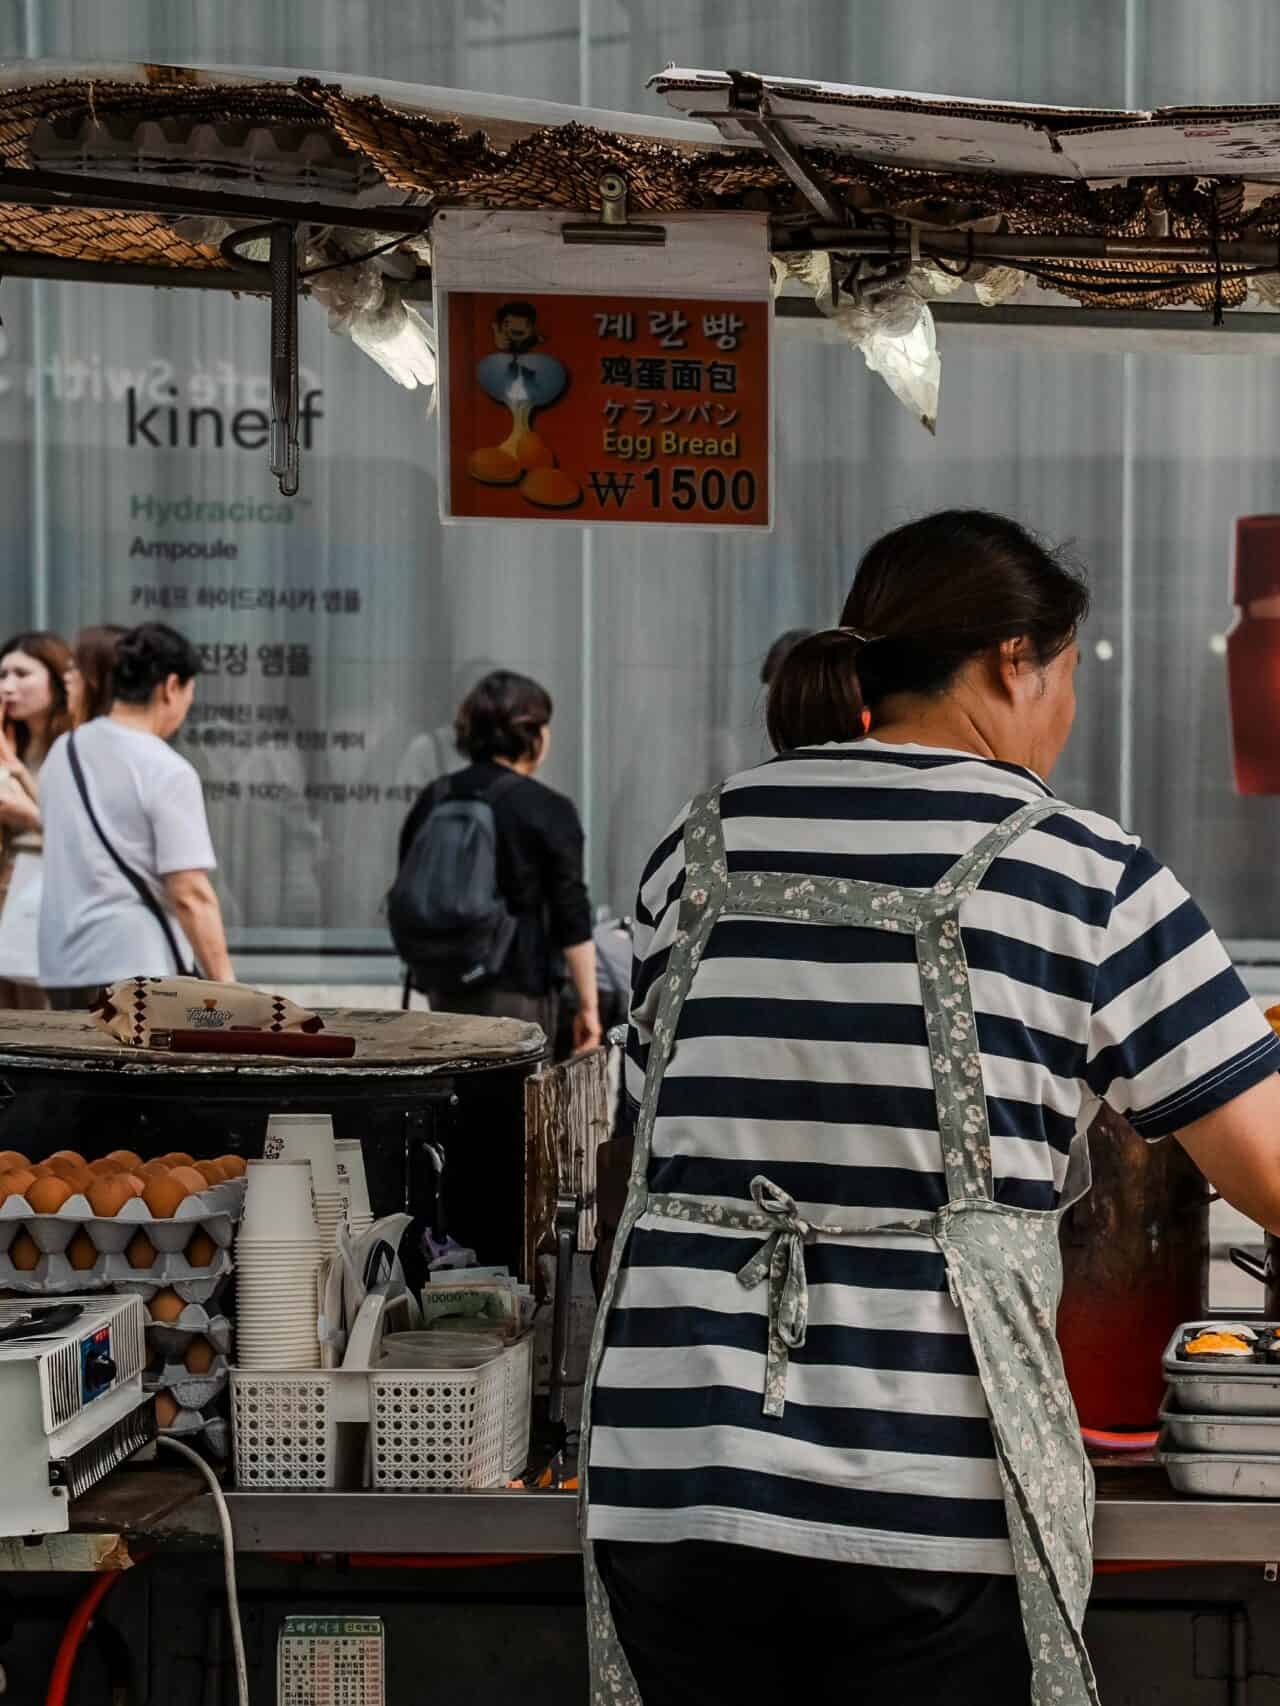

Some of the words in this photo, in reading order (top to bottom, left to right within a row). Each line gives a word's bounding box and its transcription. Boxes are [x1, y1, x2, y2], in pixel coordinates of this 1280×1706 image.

[600, 354, 738, 393] 鸡蛋面包
[126, 386, 324, 450] kinef
[602, 429, 652, 460] Egg
[661, 431, 738, 457] Bread
[129, 537, 238, 562] Ampoule
